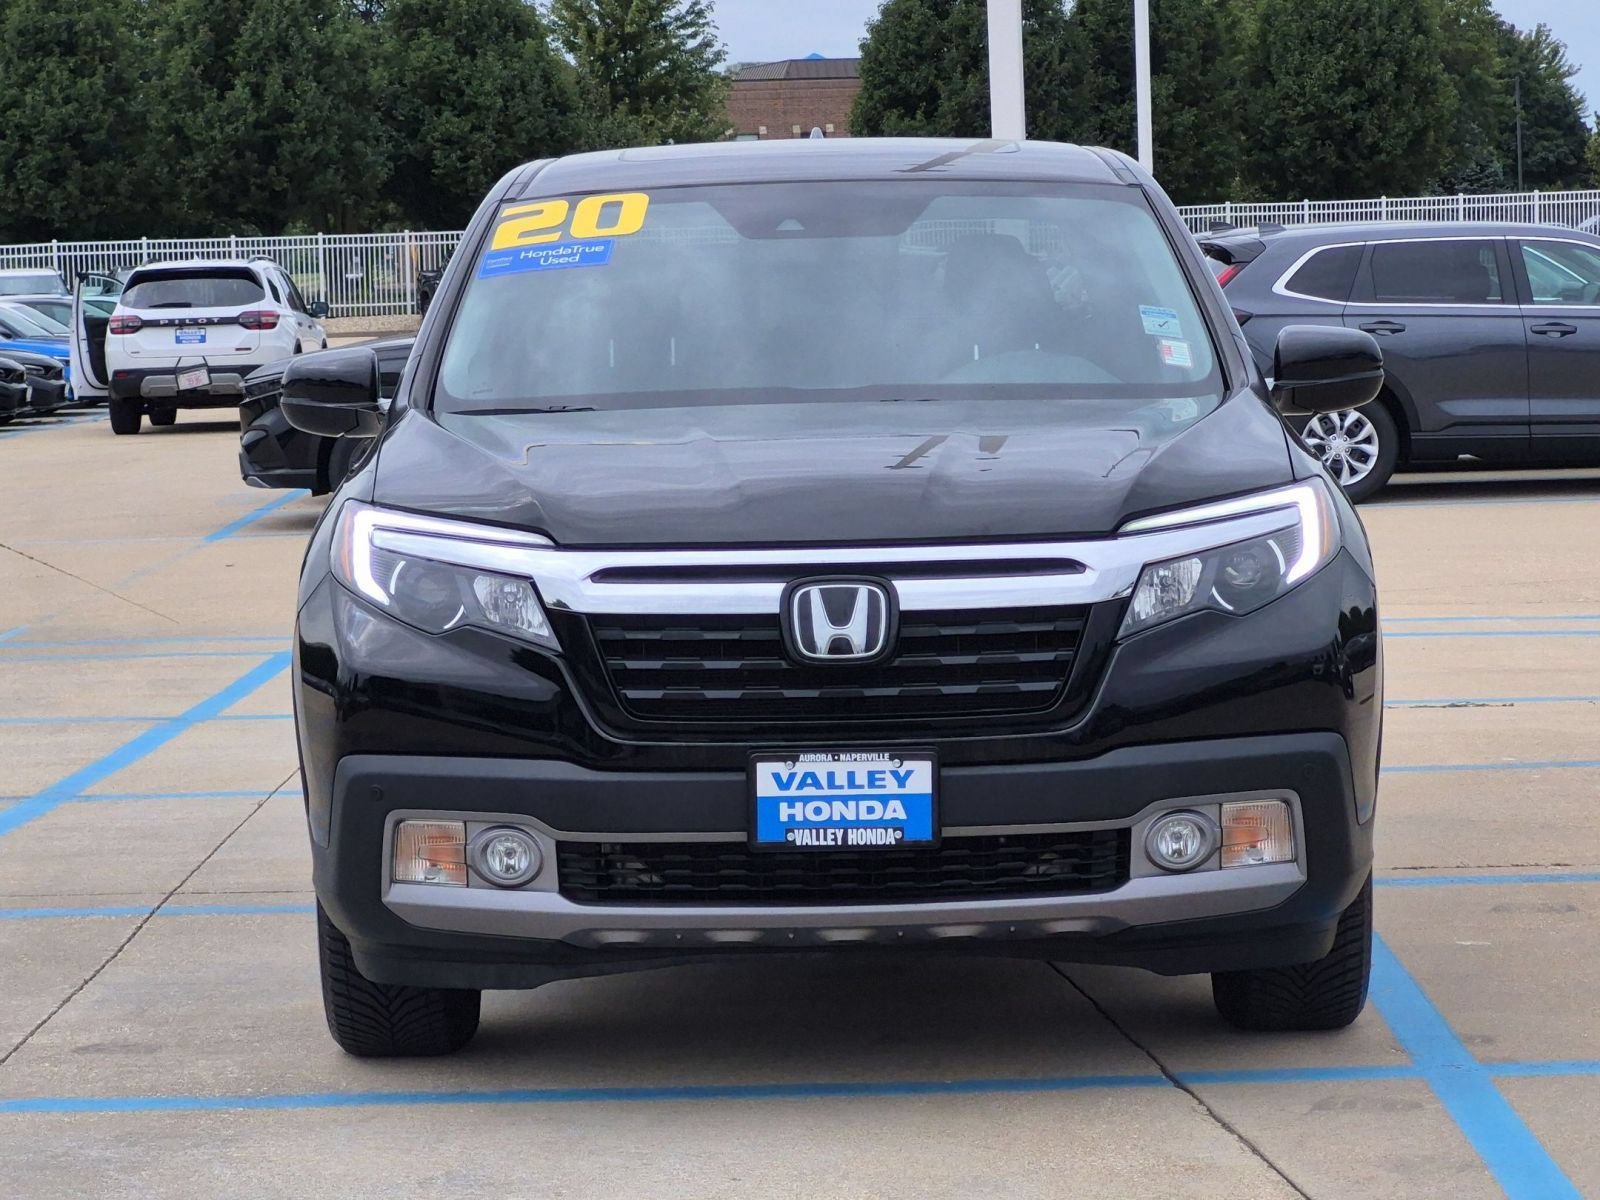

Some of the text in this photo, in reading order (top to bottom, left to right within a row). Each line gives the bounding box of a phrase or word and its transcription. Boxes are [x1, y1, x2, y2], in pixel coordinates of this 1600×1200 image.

[491, 193, 650, 250] 20
[520, 245, 605, 260] HondaTrue
[540, 254, 580, 265] Used
[160, 317, 220, 325] PILOT
[799, 753, 890, 762] AURORA NAPERVILLE
[771, 770, 915, 791] VALLEY
[780, 800, 907, 822] HONDA
[794, 828, 896, 846] VALLEY HONDA
